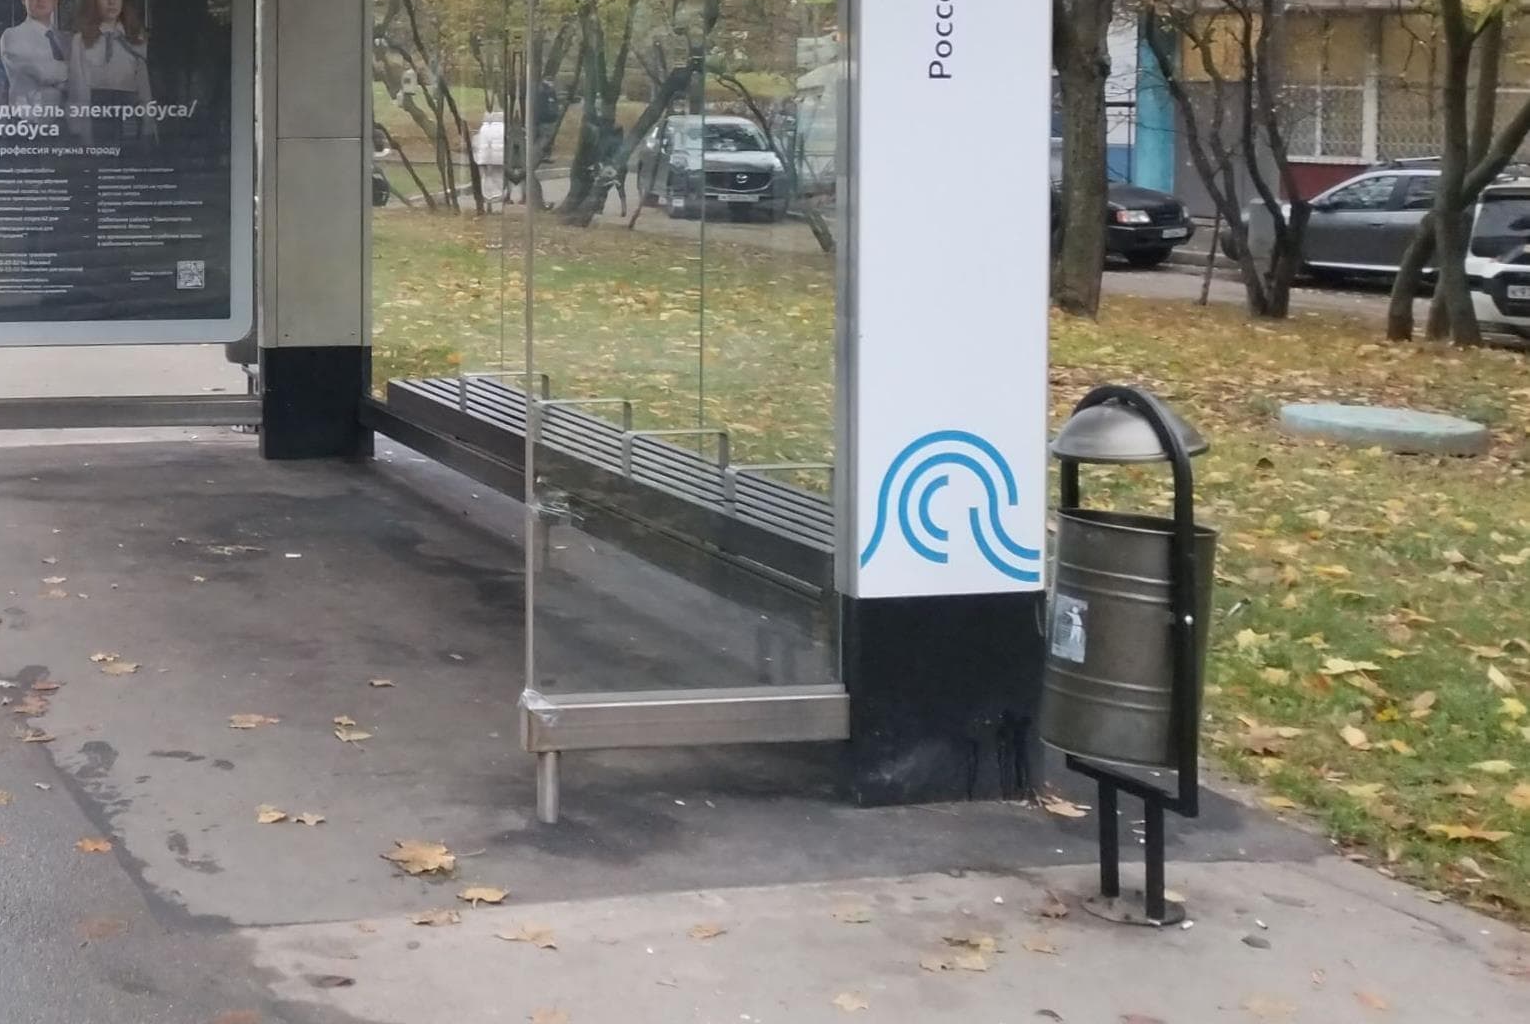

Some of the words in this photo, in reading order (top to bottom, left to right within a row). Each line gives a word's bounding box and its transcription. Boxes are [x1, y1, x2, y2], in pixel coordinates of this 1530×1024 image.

[69, 99, 198, 121] электробуса/
[51, 146, 84, 157] нужна
[85, 146, 121, 158] городу
